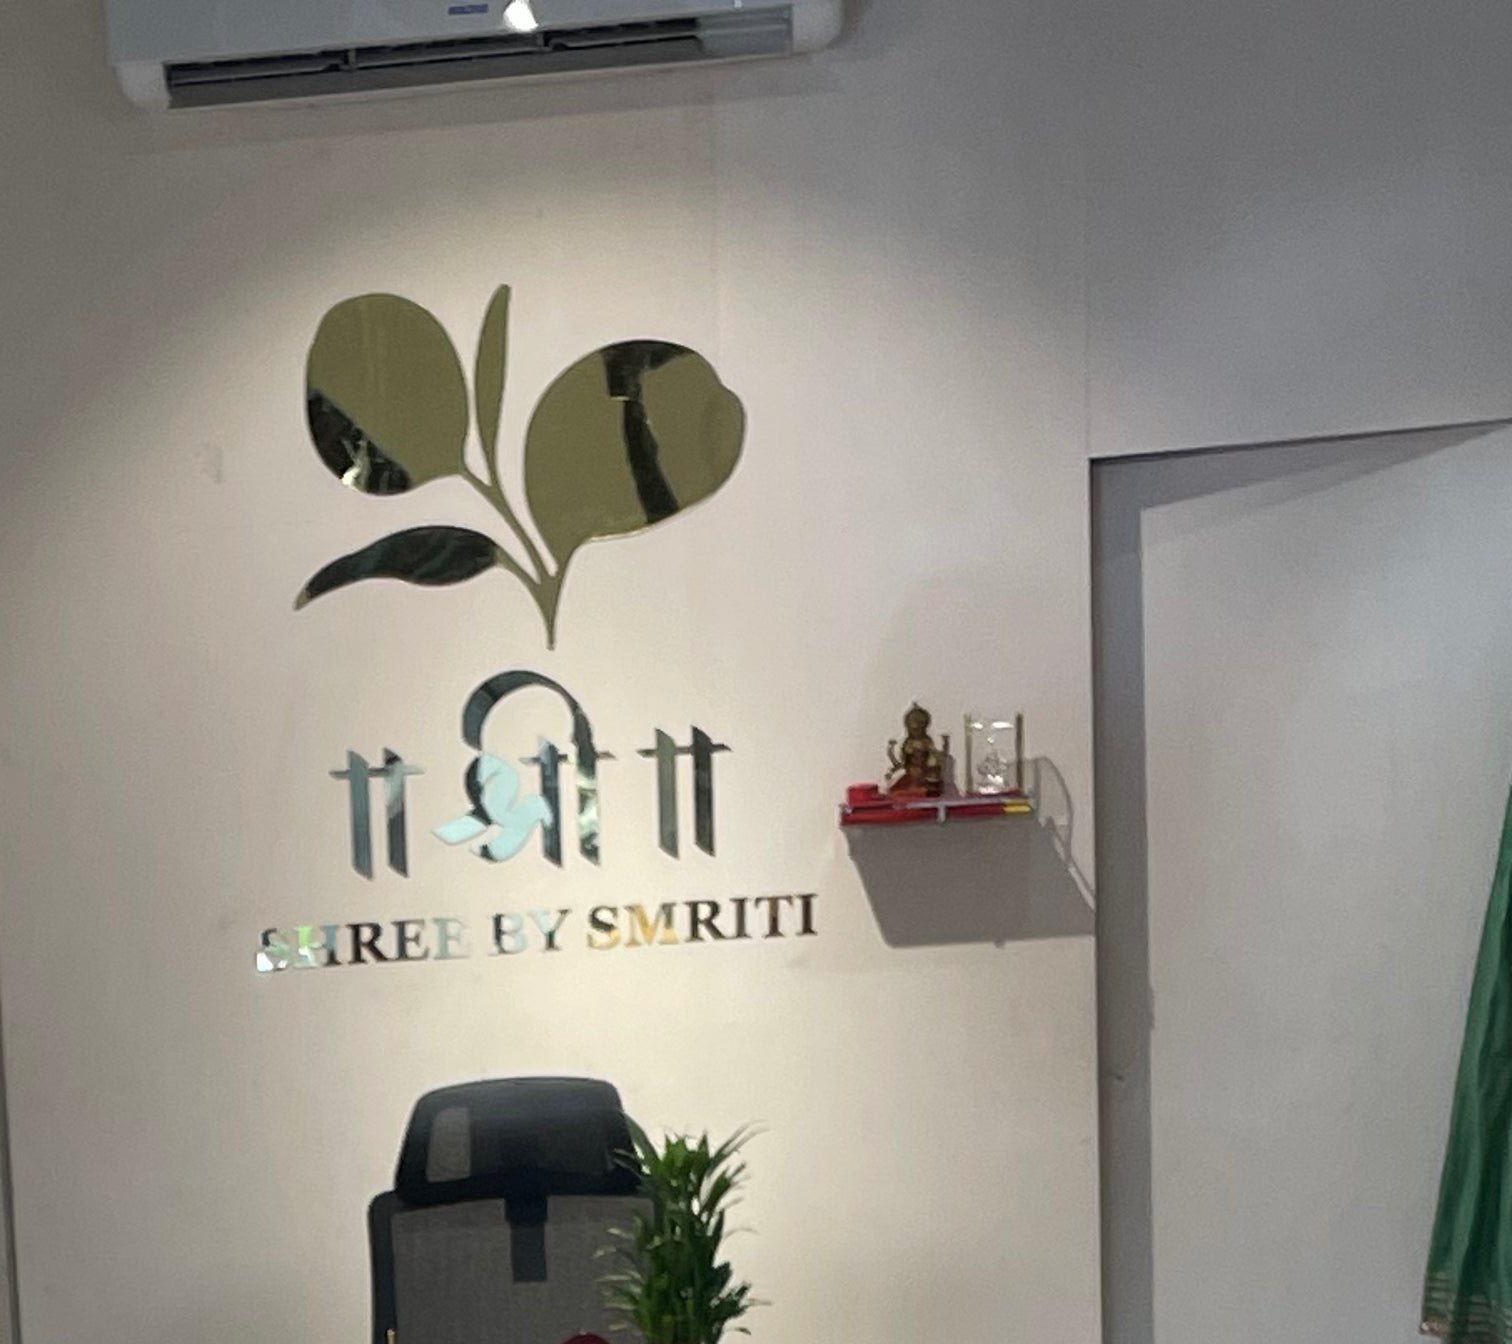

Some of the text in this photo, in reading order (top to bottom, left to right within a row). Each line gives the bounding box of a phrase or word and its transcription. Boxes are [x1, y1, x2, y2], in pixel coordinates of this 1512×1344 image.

[255, 892, 819, 974] SHREE BY SMRITI
